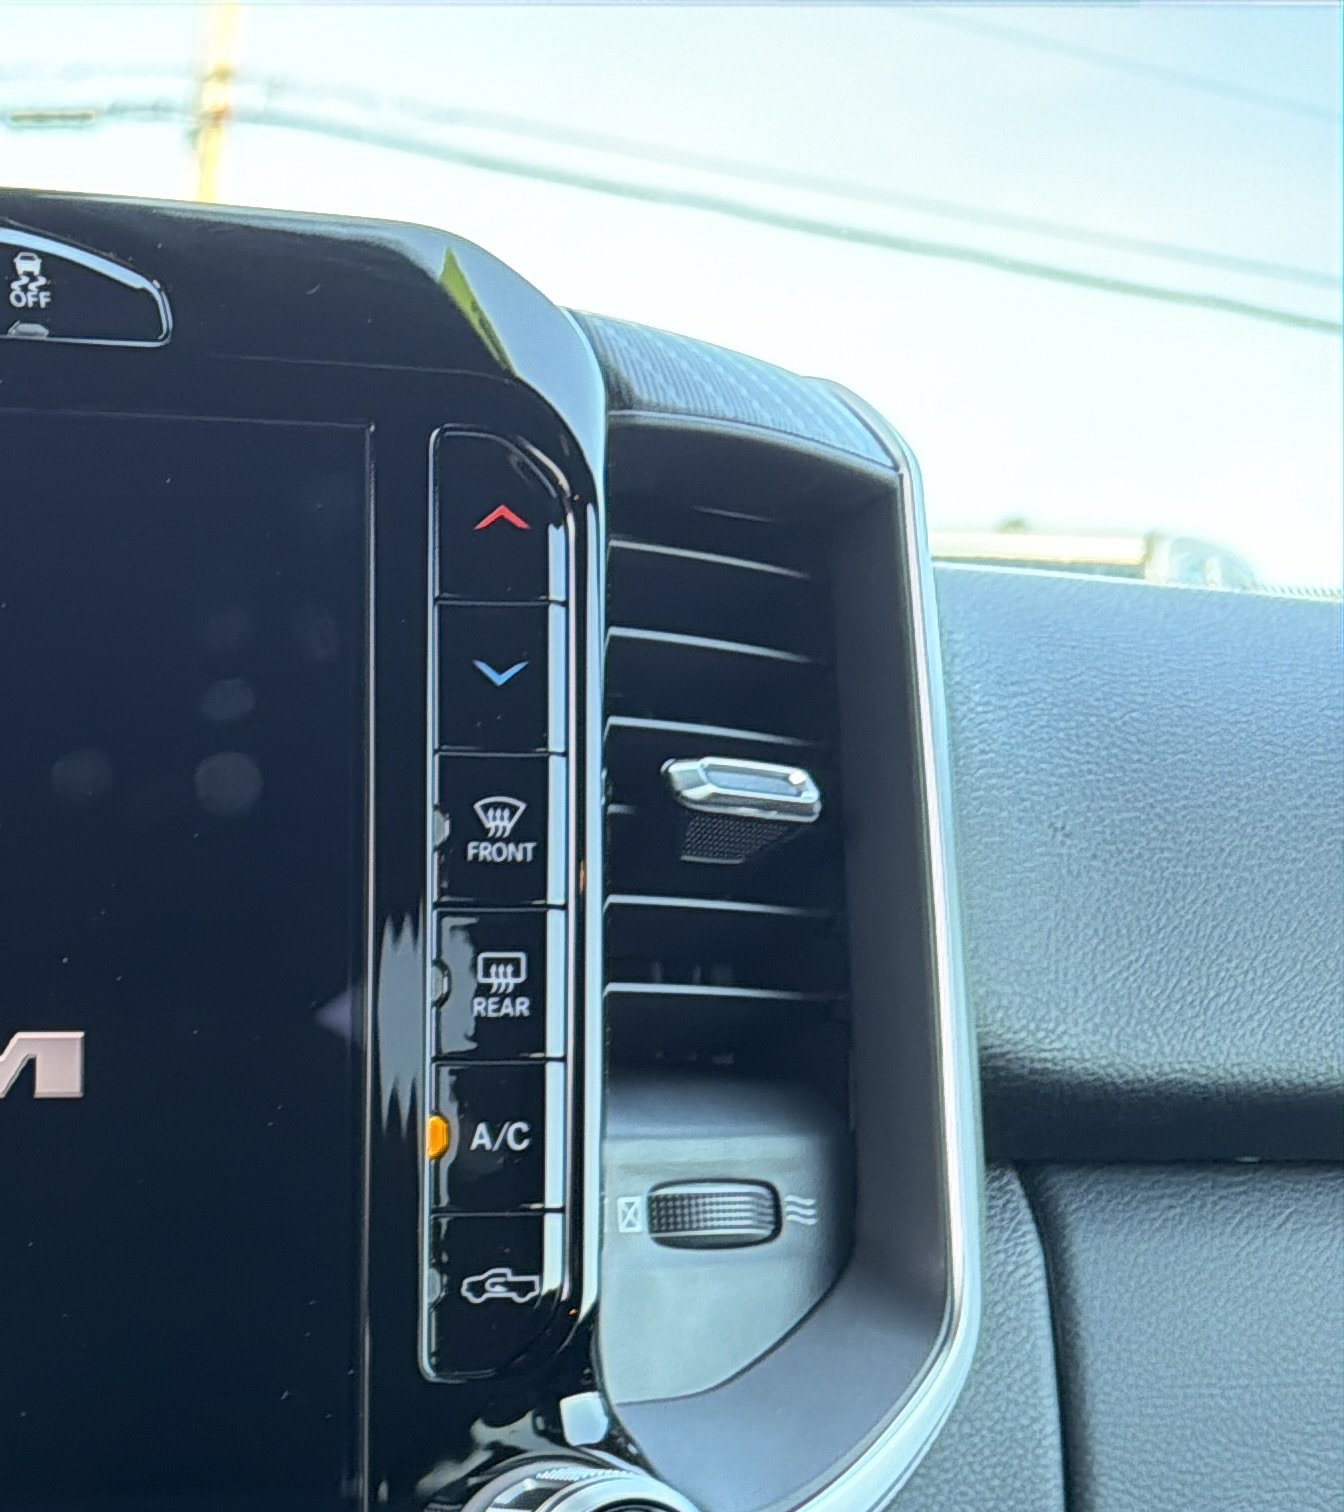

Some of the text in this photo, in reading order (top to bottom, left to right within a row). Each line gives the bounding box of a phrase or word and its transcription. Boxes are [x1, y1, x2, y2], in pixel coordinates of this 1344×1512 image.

[9, 290, 52, 308] OFF
[466, 841, 538, 862] FRONT
[472, 996, 531, 1018] REAR
[470, 1120, 531, 1152] A/C
